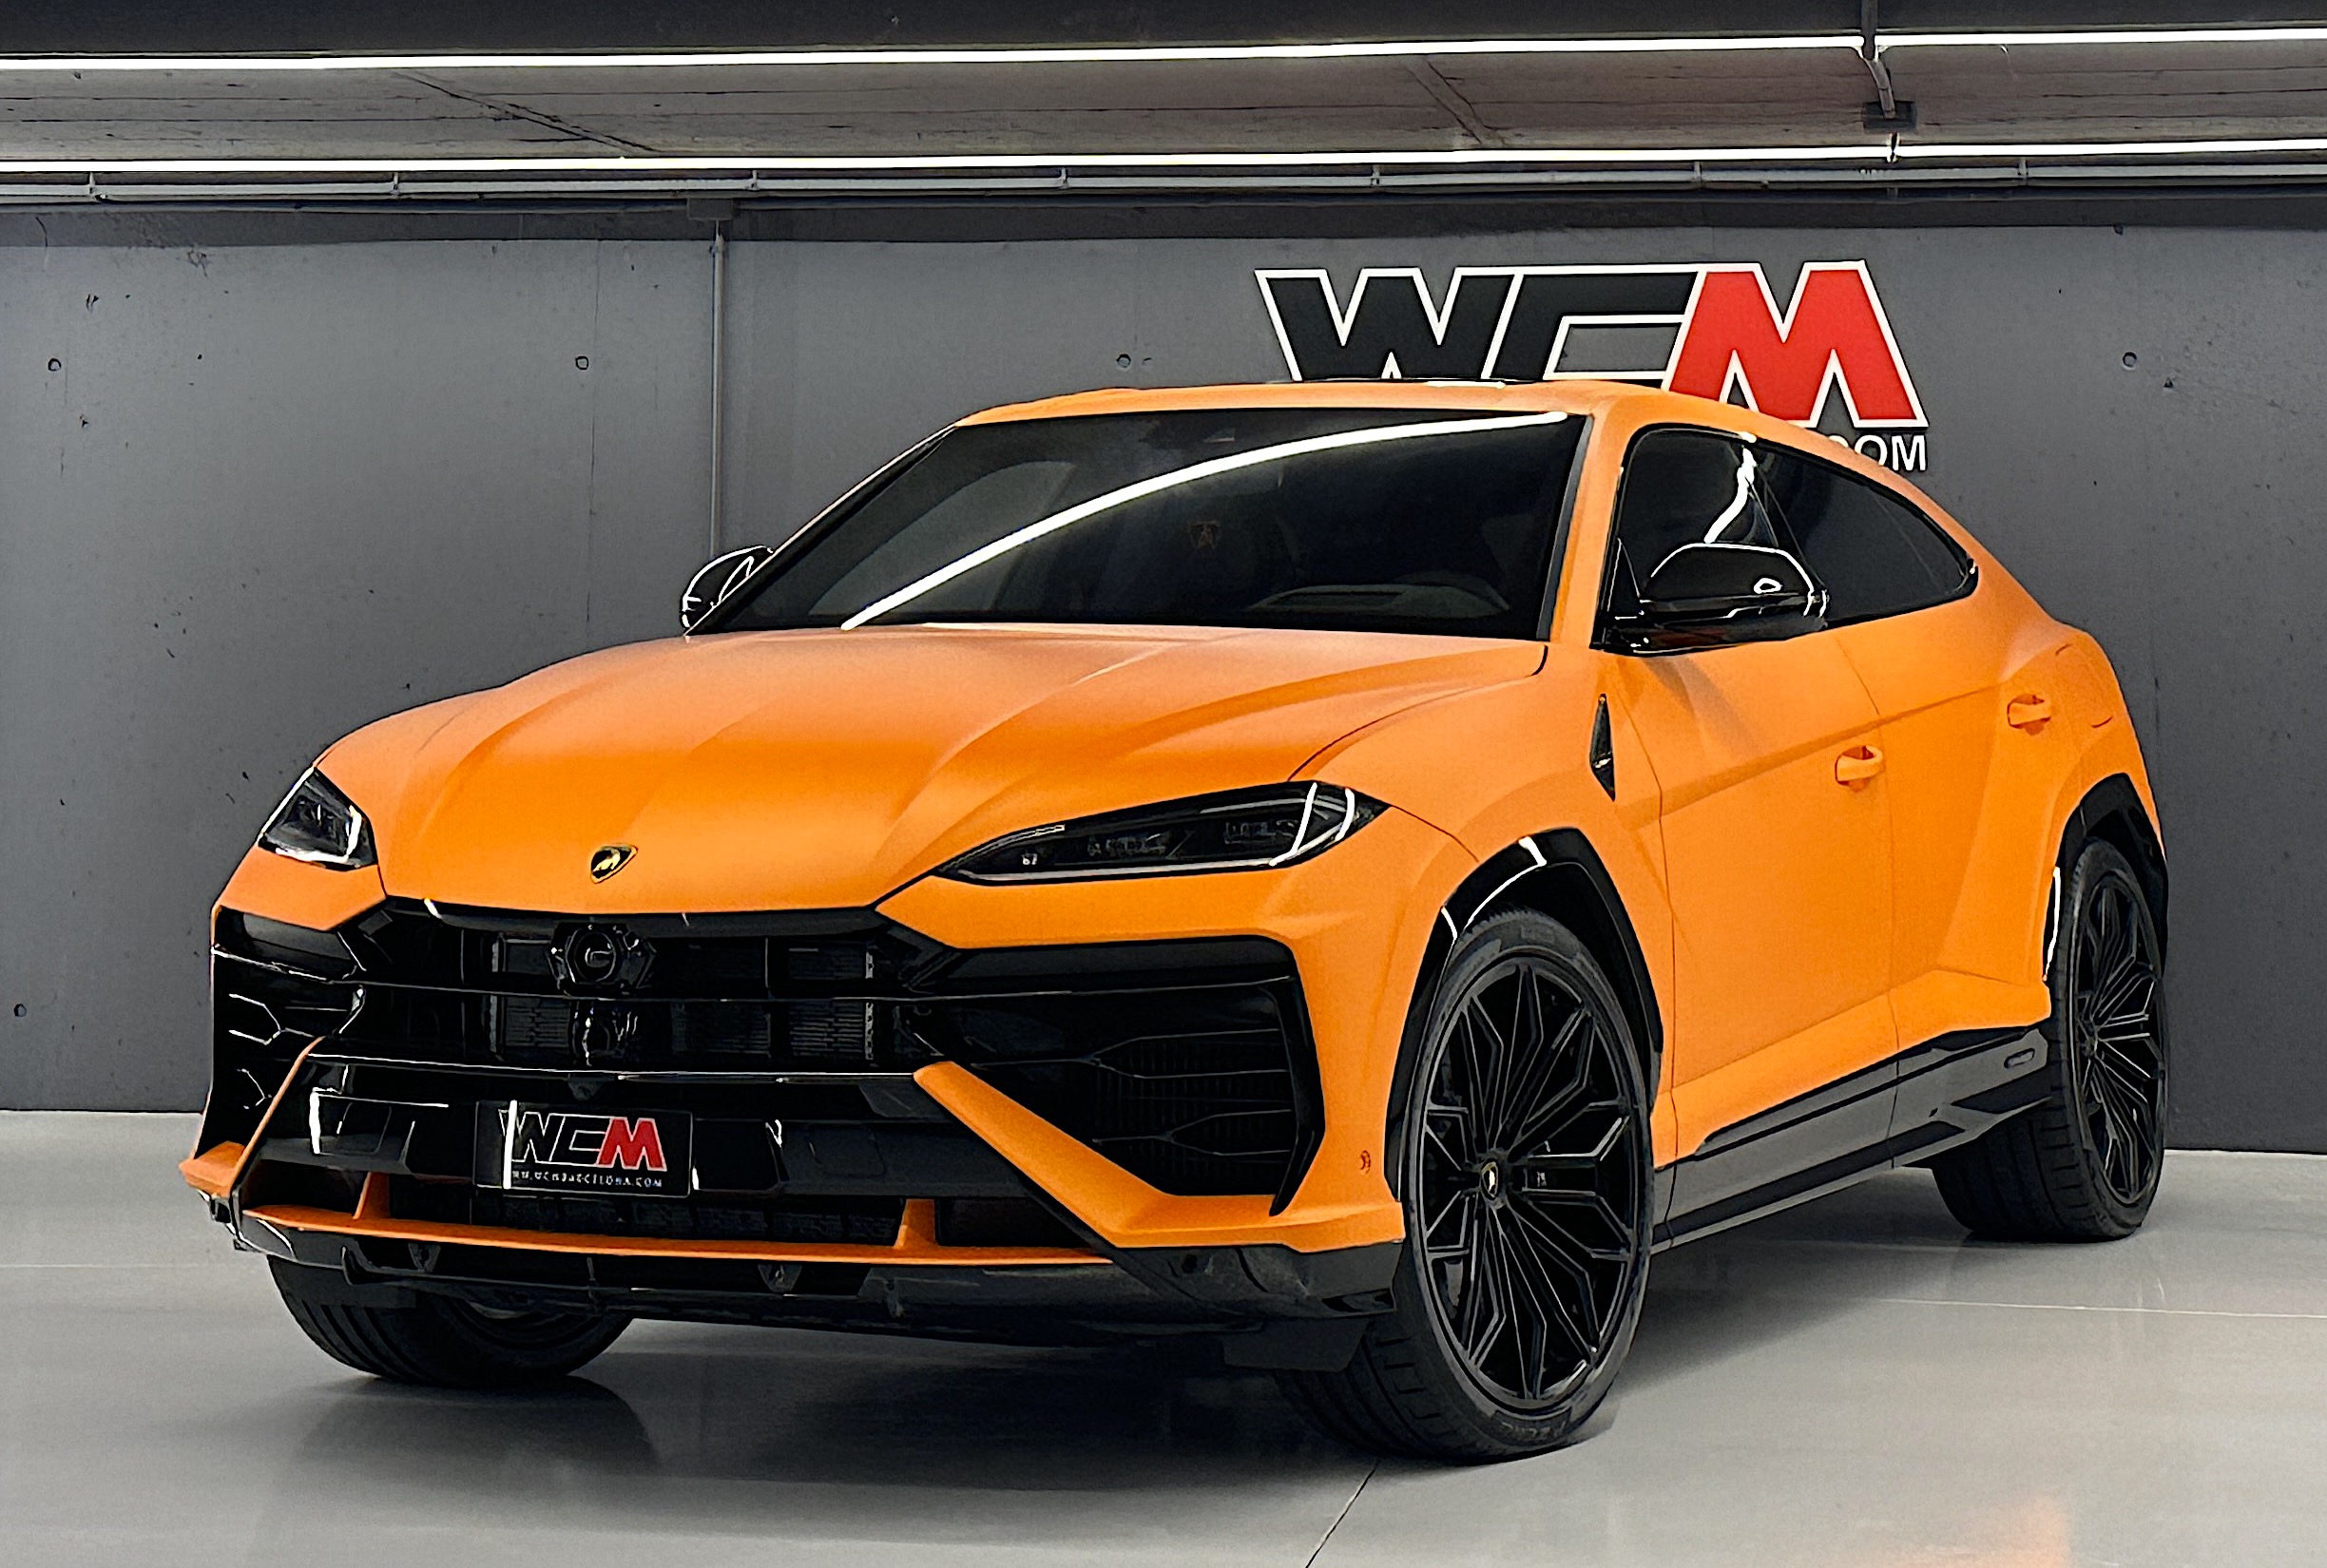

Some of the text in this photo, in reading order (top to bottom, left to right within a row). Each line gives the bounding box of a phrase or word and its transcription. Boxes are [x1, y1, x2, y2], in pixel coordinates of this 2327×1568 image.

[1255, 259, 1929, 429] WCM
[1829, 434, 1927, 471] OM
[498, 1110, 667, 1172] WCM
